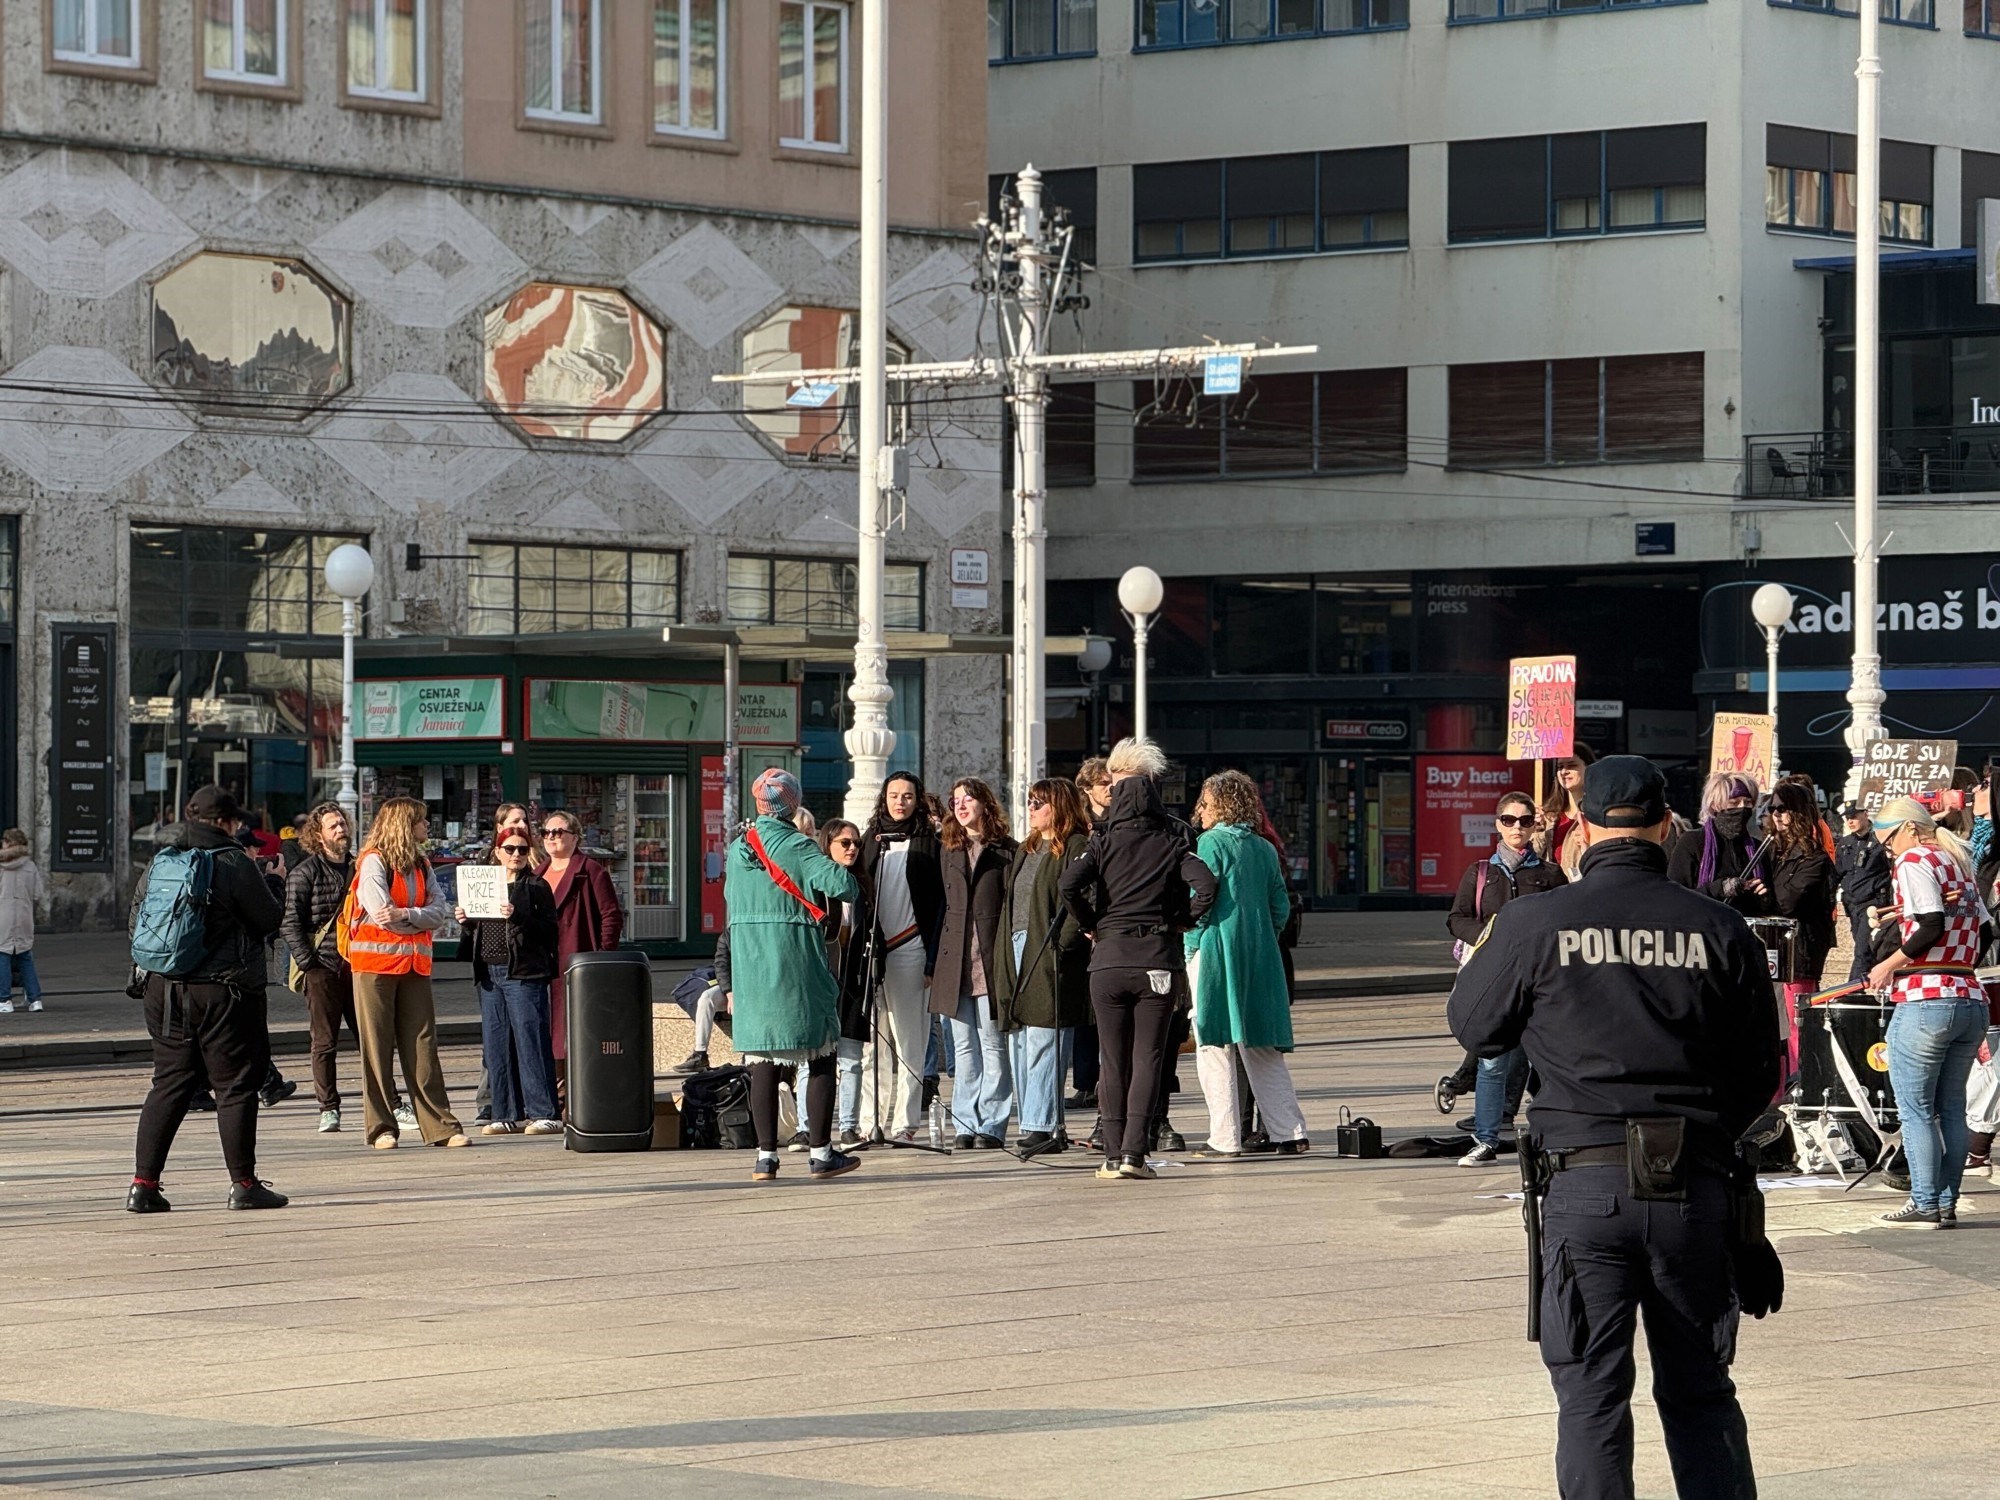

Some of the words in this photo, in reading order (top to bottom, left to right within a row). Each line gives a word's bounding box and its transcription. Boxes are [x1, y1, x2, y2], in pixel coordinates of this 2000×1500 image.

[1427, 601, 1468, 617] press
[1512, 663, 1554, 686] PRAVO
[1555, 662, 1576, 683] NA
[418, 688, 461, 699] CENTAR
[738, 694, 765, 705] NTAR
[418, 699, 486, 713] OSVJEŽENJA
[738, 705, 788, 718] VJEŽENJA
[415, 716, 466, 734] Jamnica
[1715, 715, 1730, 725] MOJA
[1331, 724, 1362, 735] TISAK
[1369, 724, 1402, 735] media
[1509, 728, 1565, 746] SPASAVA
[1871, 743, 1911, 761] GDJE
[1917, 744, 1941, 761] SU
[1426, 766, 1464, 788] Buy
[1468, 767, 1513, 784] here!
[1863, 762, 1923, 780] MOLITVE
[1927, 764, 1950, 780] ZA
[1426, 790, 1468, 799] Unlimited
[1440, 800, 1450, 808] 10
[1452, 800, 1474, 810] days
[467, 881, 495, 899] MRZE
[1558, 927, 1709, 970] POLICIJA
[601, 1041, 624, 1055] JBL
